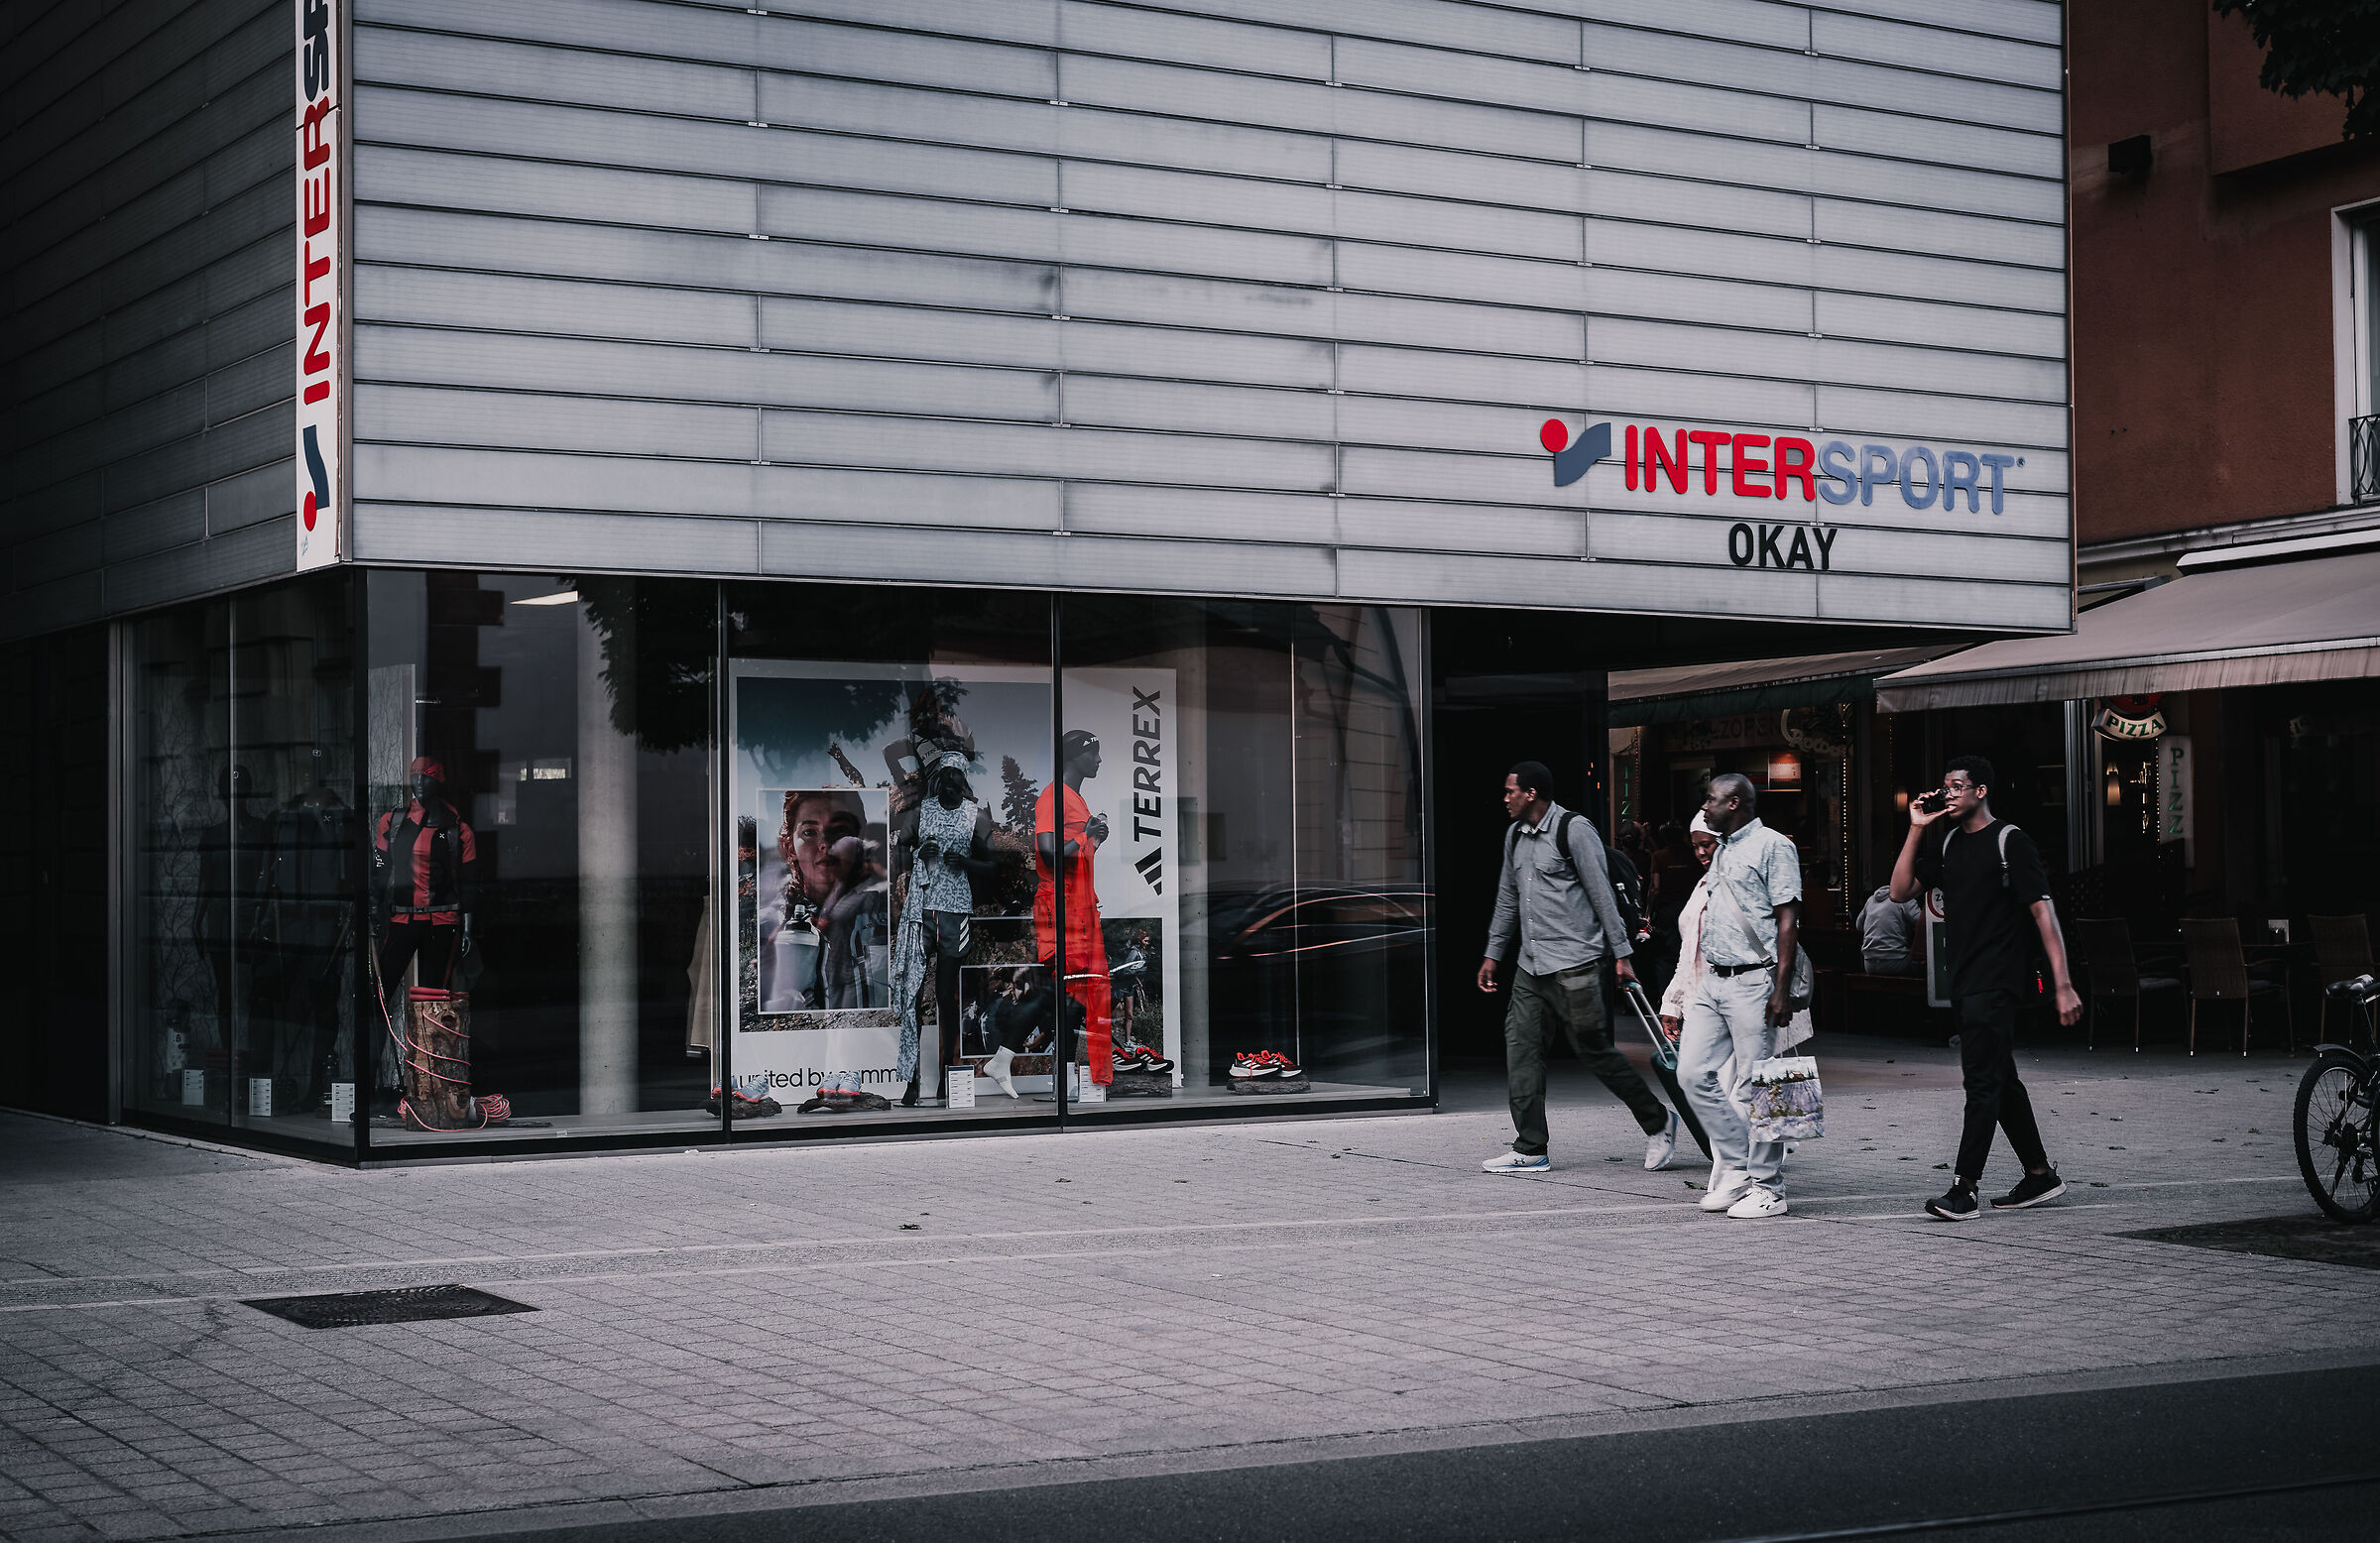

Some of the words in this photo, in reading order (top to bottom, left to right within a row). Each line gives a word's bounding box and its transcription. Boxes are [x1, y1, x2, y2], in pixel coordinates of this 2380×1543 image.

[1727, 522, 1839, 570] OKAY
[2106, 713, 2164, 738] PIZZA
[1131, 684, 1162, 843] TERREX
[739, 1067, 804, 1089] uted
